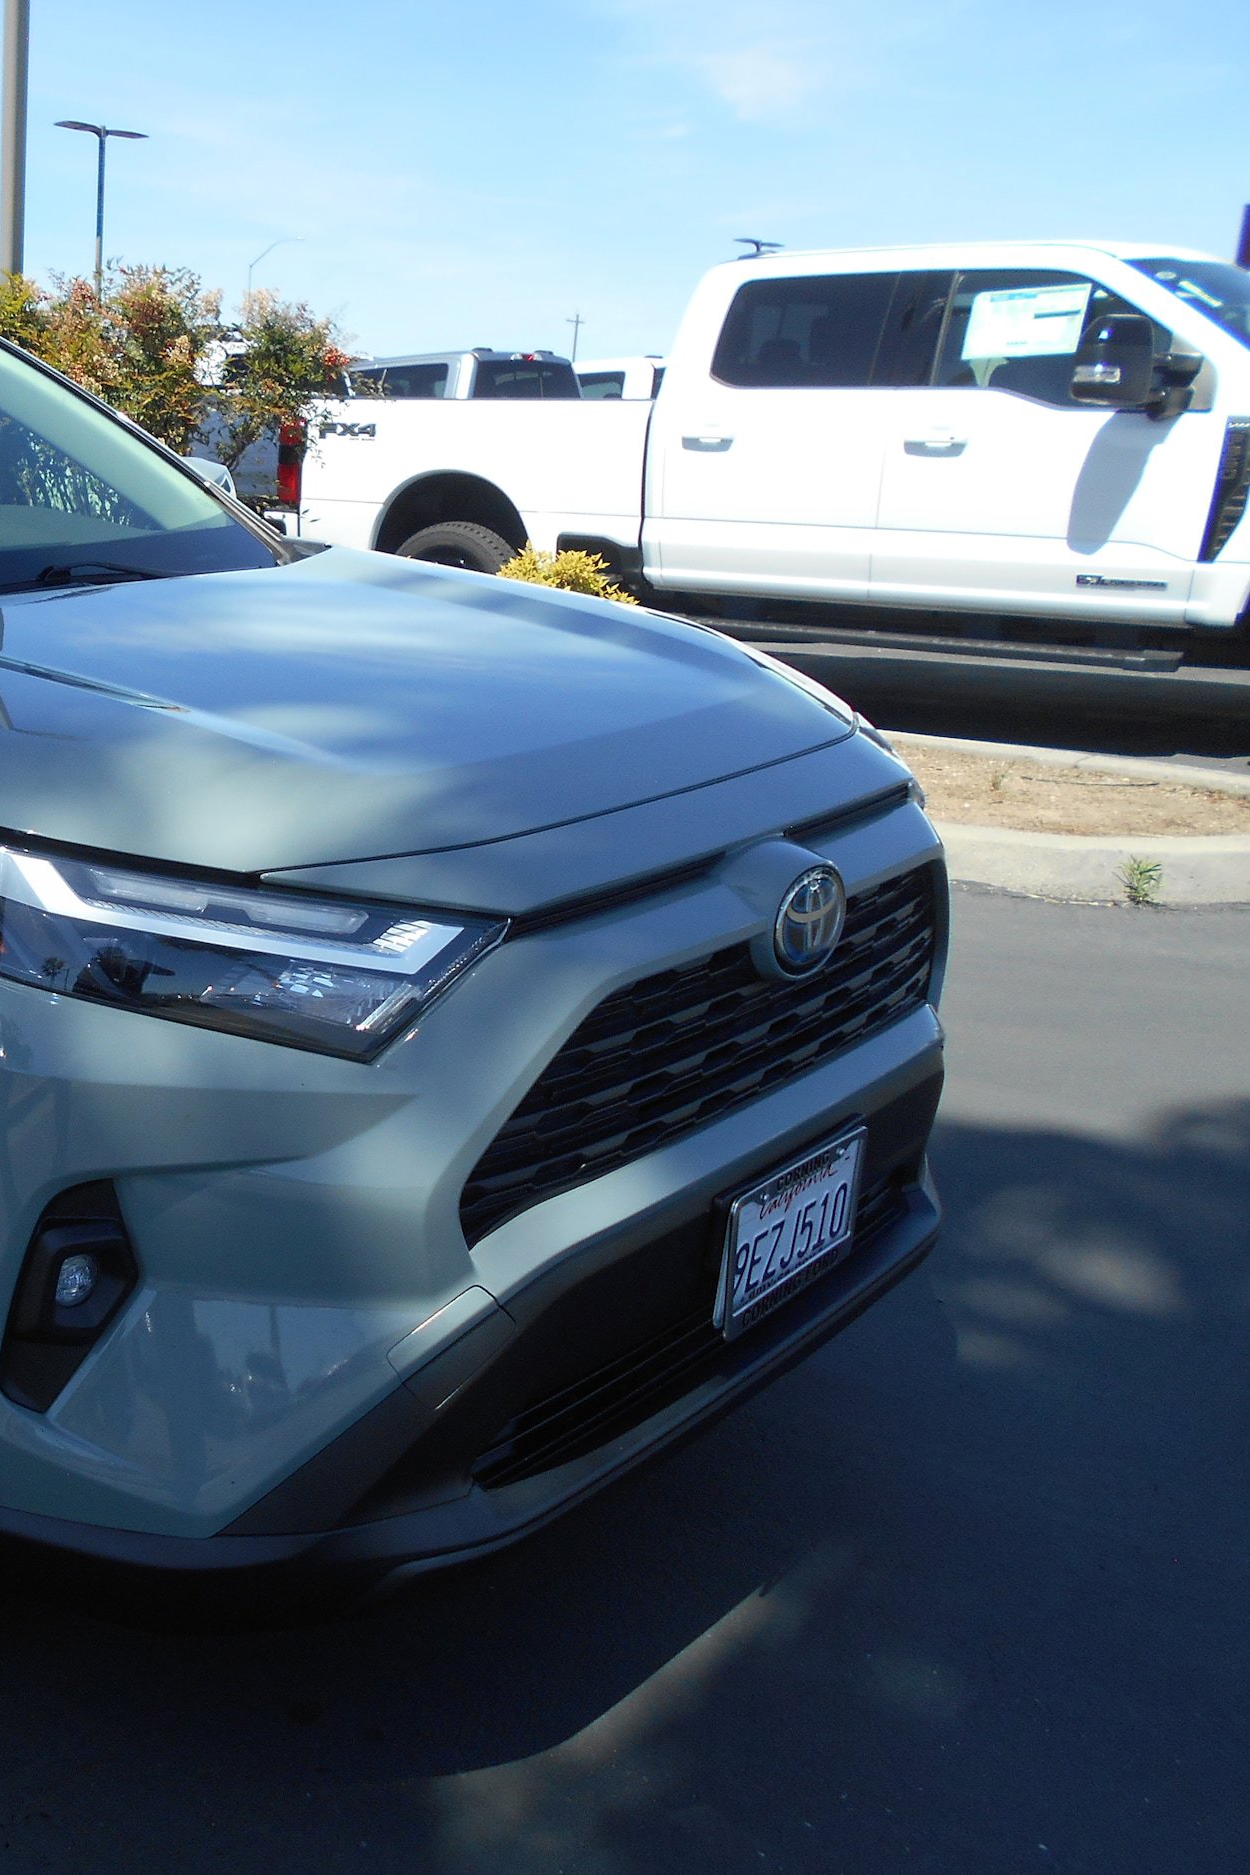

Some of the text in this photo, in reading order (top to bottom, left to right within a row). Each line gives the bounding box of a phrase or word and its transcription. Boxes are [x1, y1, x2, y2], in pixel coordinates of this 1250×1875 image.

[319, 422, 376, 439] FX4
[777, 1151, 830, 1192] CORNING
[733, 1182, 848, 1295] 9EZJ510
